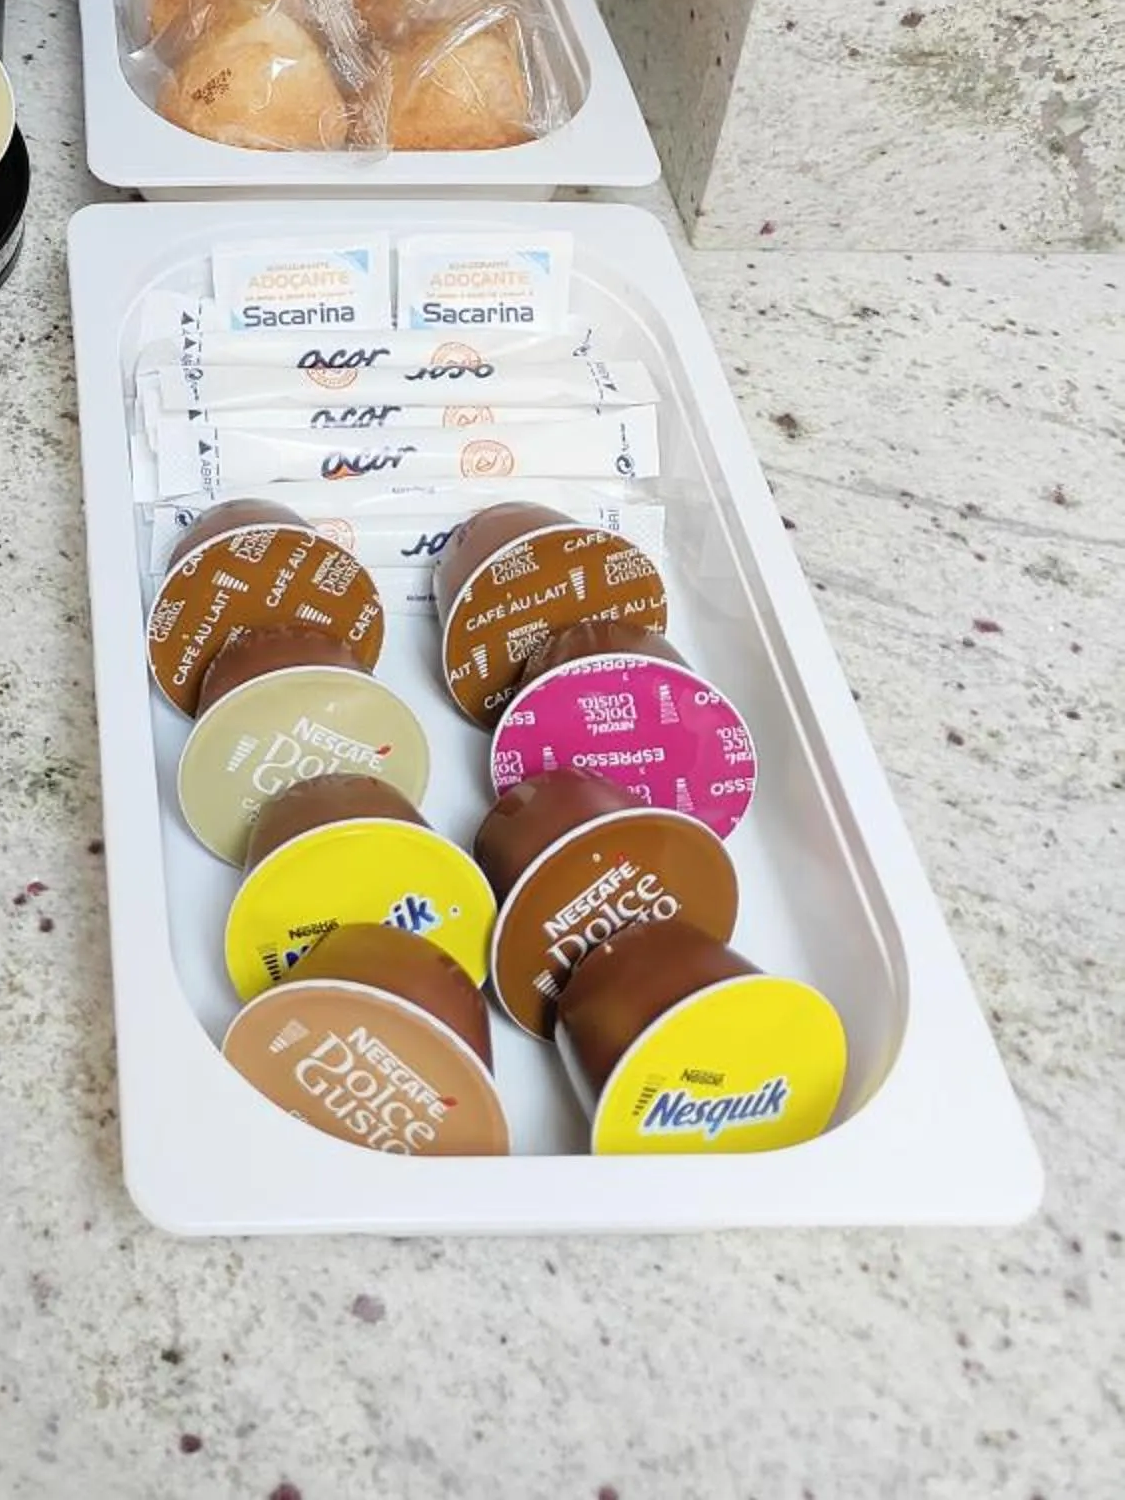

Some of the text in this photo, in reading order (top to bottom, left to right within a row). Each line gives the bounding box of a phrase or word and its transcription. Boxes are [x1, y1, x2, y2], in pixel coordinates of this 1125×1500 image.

[242, 302, 355, 327] Sacarina
[422, 302, 535, 324] Sacarina
[266, 547, 308, 607] CAFÉ AU
[349, 603, 380, 641] CAFÉ
[466, 581, 569, 631] CAFÉ AU LAIT
[623, 598, 646, 617] AU
[172, 589, 231, 685] CAFÉ AU LAIT
[584, 705, 638, 723] Dolce
[572, 747, 666, 768] ESPRESSO
[547, 873, 664, 969] Dolce
[311, 1031, 436, 1150] Dolce
[642, 1076, 789, 1135] Nesquik
